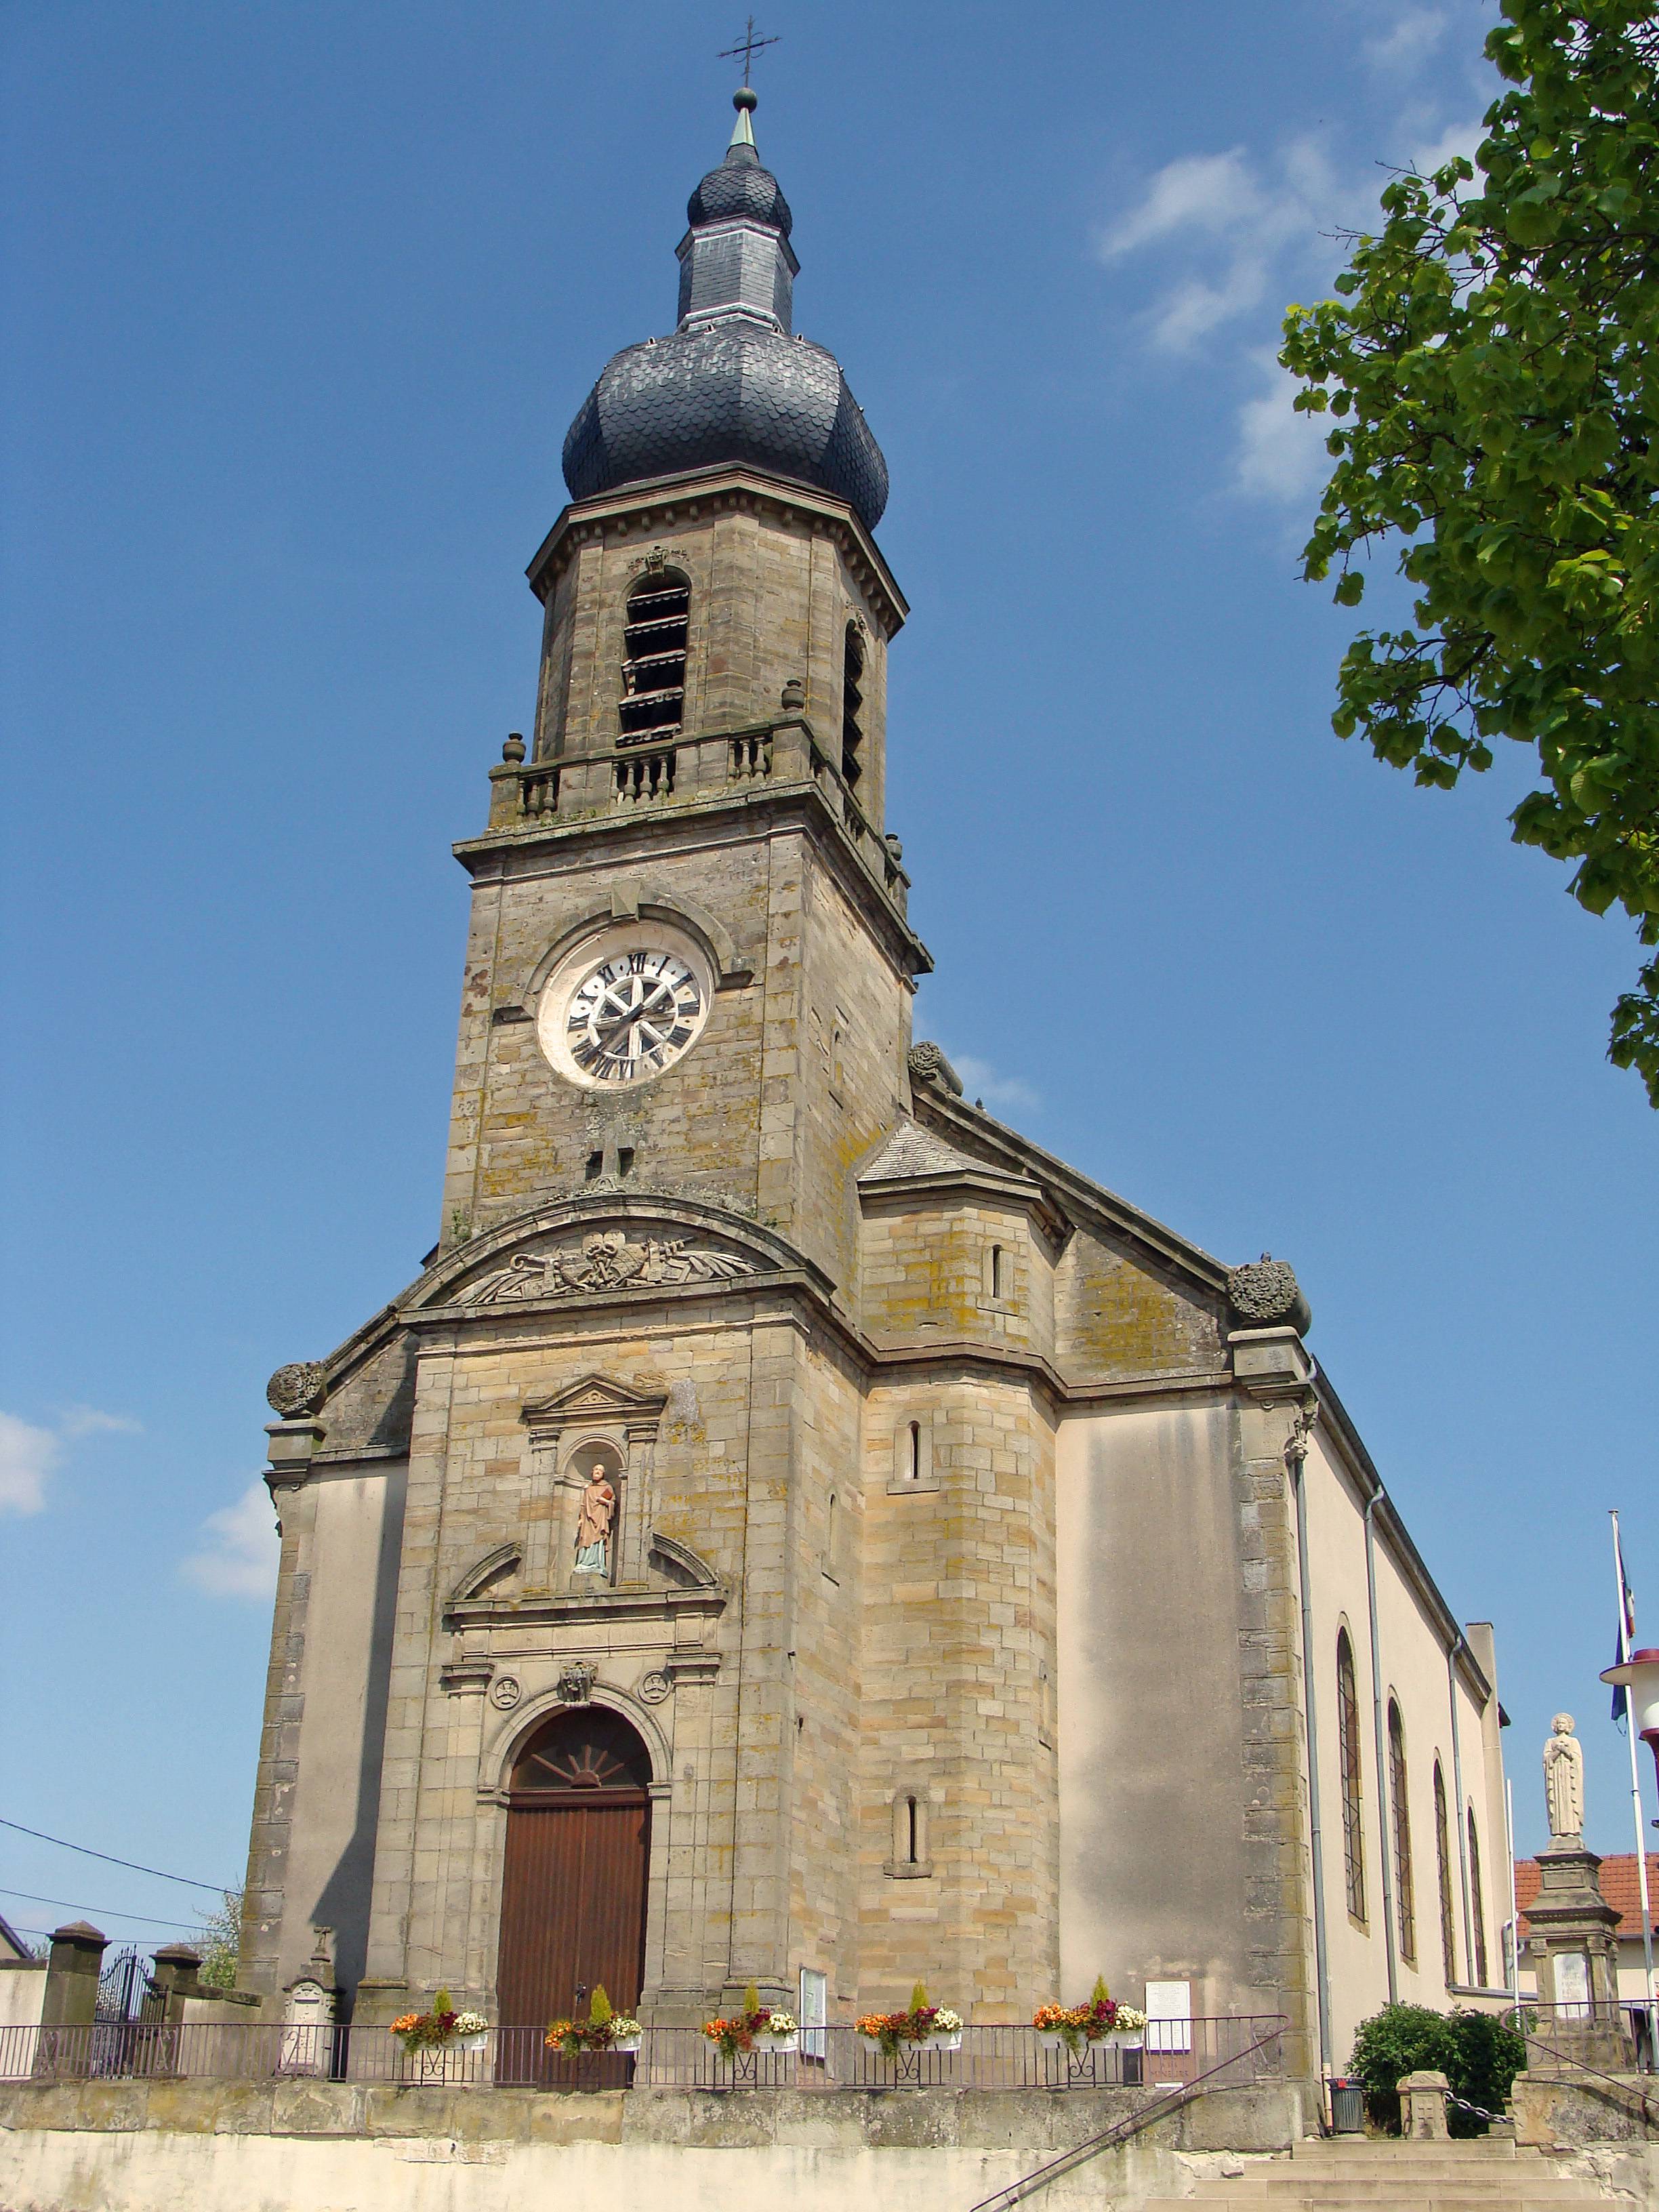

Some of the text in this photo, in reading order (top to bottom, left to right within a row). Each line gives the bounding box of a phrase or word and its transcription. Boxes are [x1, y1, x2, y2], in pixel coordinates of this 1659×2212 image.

[626, 952, 647, 976] XII
[655, 956, 672, 977] I
[597, 964, 617, 989] XI
[577, 989, 598, 1005] X
[678, 1000, 700, 1017] III
[568, 1013, 590, 1031] IX
